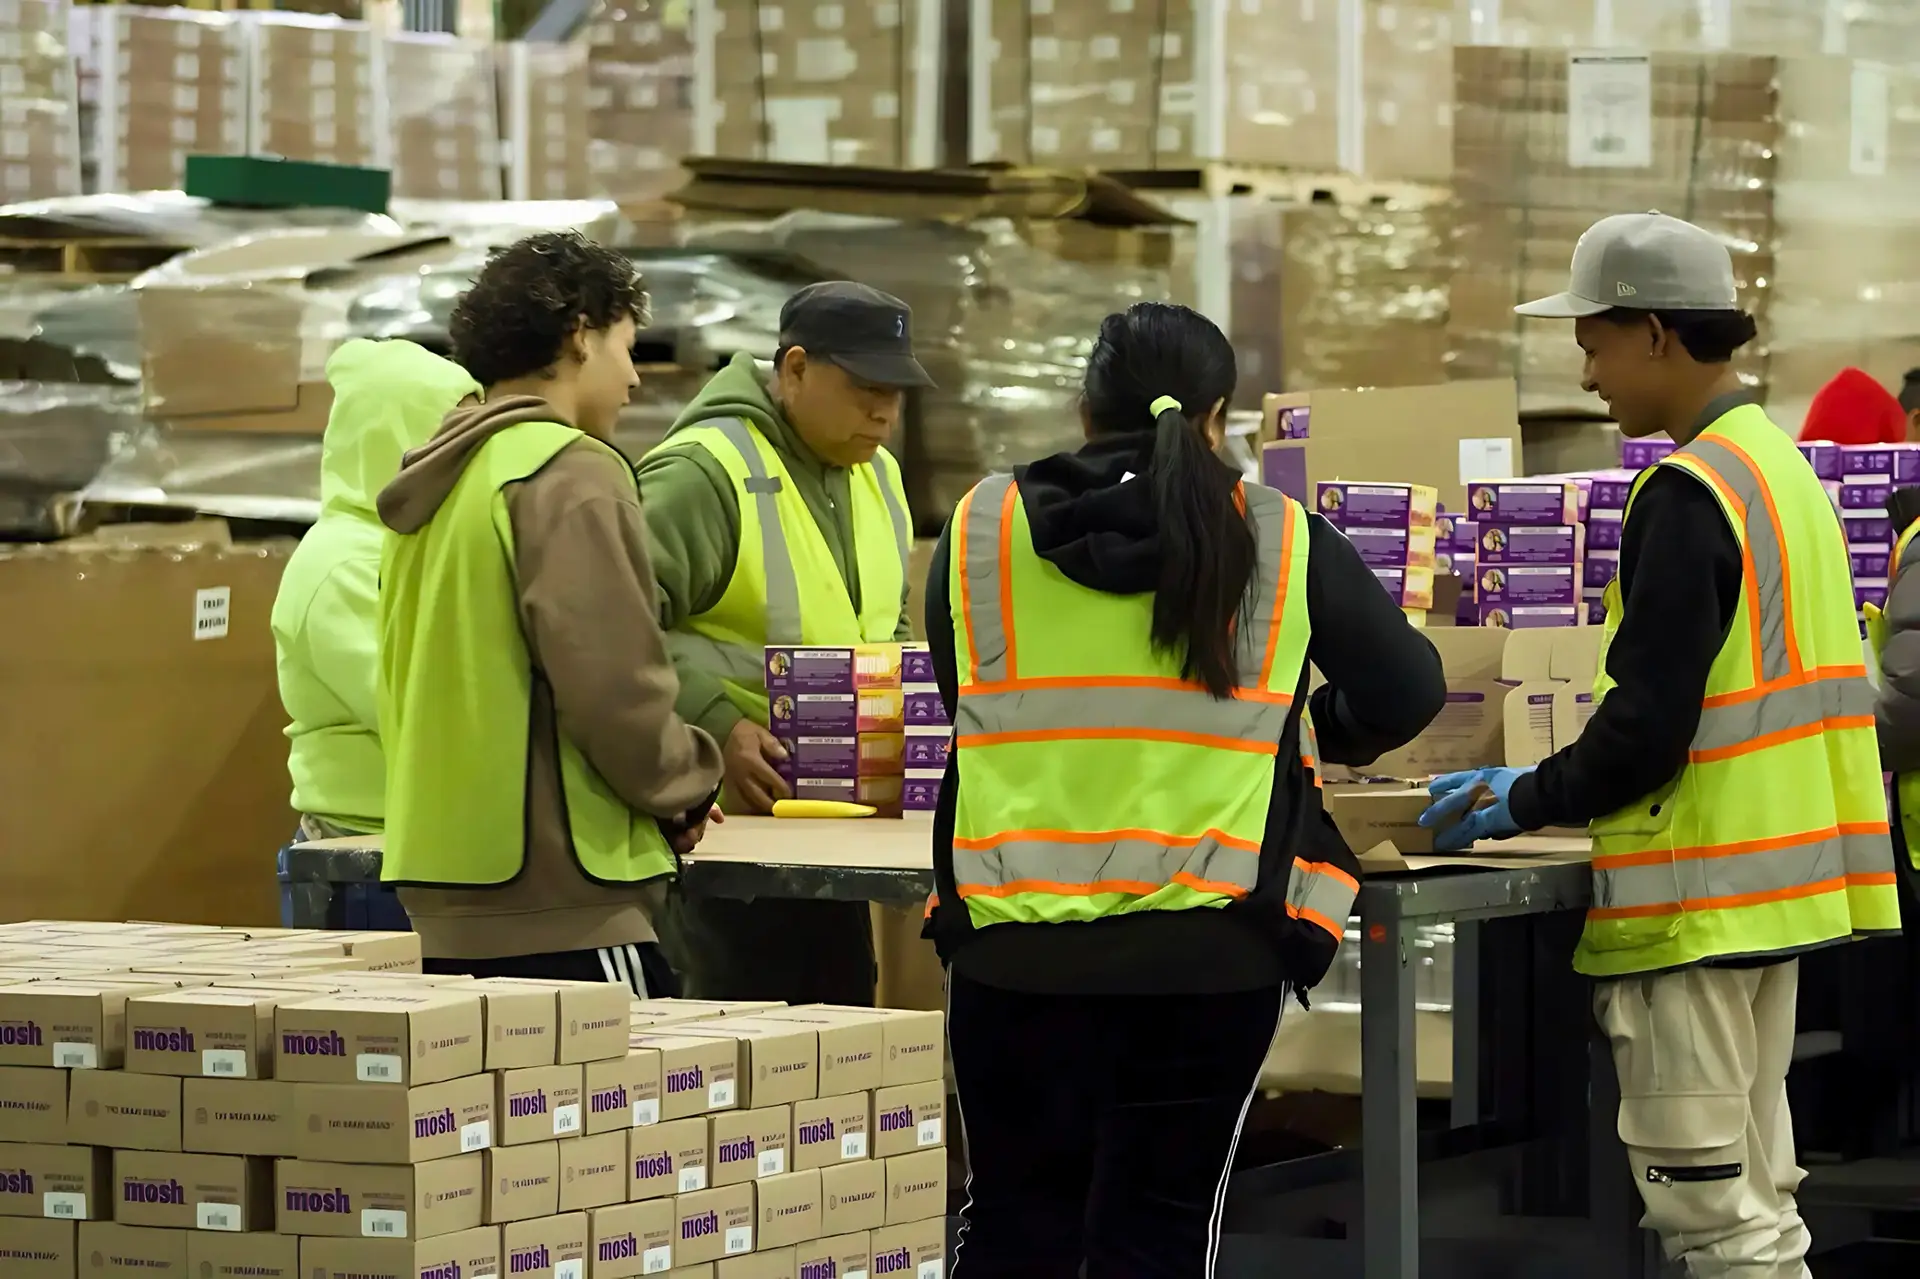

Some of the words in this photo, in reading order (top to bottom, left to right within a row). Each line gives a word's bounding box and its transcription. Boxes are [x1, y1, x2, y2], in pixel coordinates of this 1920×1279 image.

[0, 1021, 43, 1046] osh
[135, 1026, 195, 1053] mosh
[283, 1030, 346, 1056] mosh
[667, 1065, 703, 1093] mosh
[509, 1088, 547, 1117] mosh
[591, 1084, 627, 1112] mosh
[415, 1107, 456, 1138] mosh
[799, 1117, 835, 1144] mosh
[879, 1105, 913, 1131] mosh
[719, 1136, 755, 1163] mosh
[635, 1151, 673, 1179] mosh
[0, 1169, 33, 1194] osh
[124, 1178, 186, 1204] mosh
[286, 1187, 351, 1213] mosh
[681, 1210, 719, 1240] mosh
[510, 1244, 550, 1273] mosh
[599, 1232, 637, 1261] mosh
[875, 1247, 911, 1274] mosh
